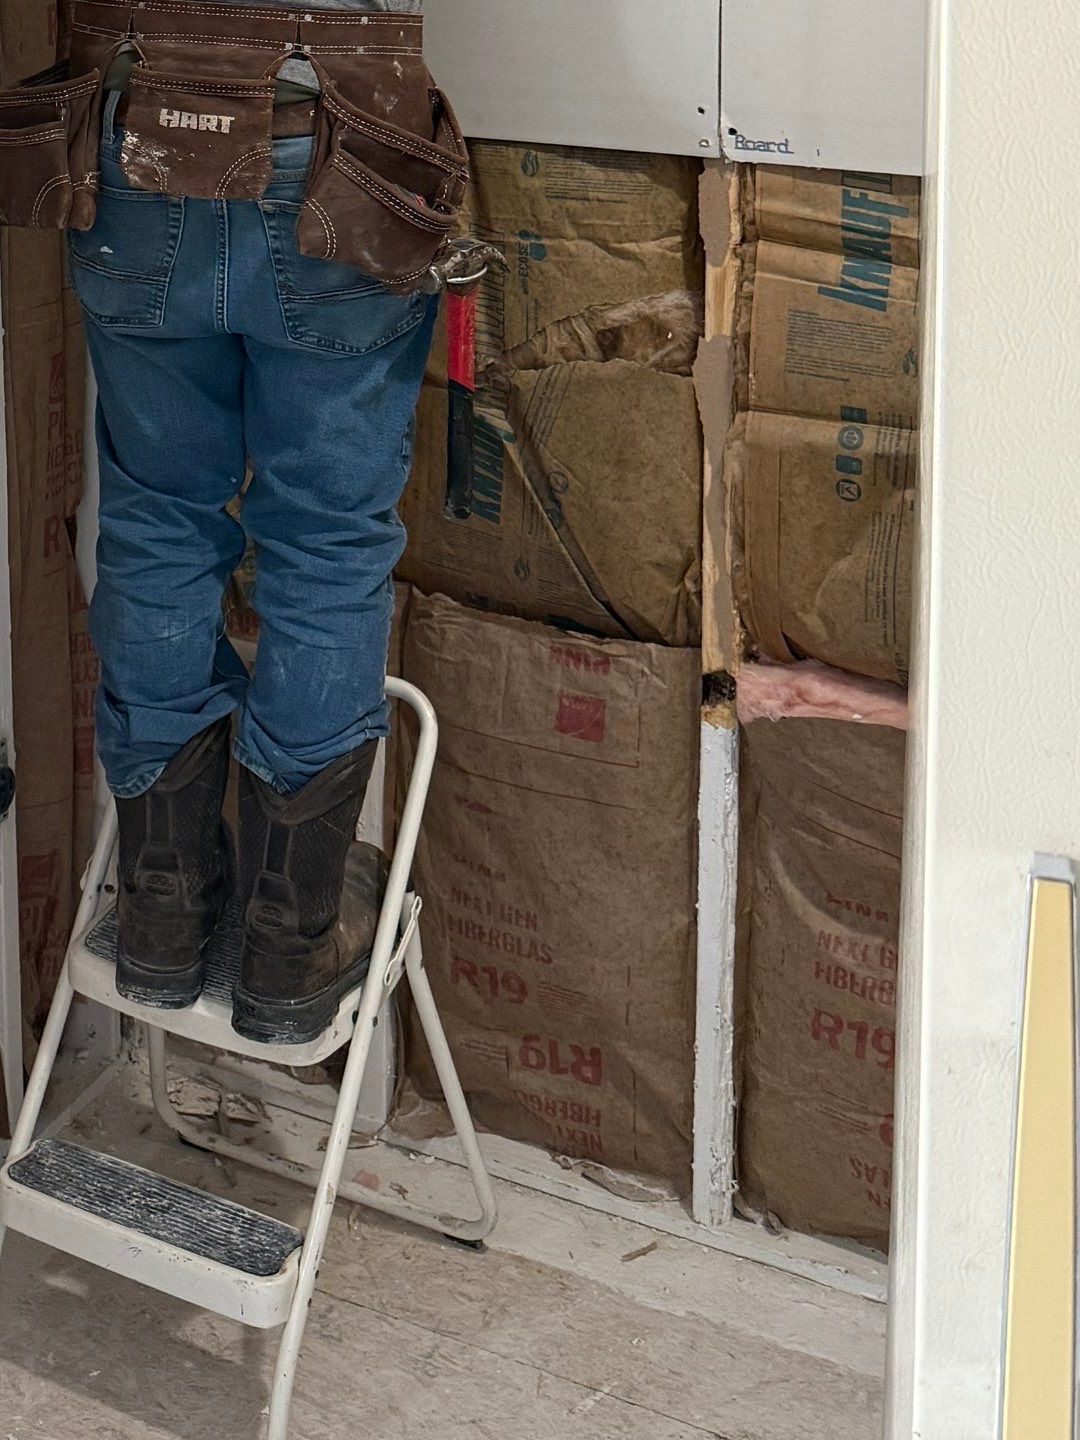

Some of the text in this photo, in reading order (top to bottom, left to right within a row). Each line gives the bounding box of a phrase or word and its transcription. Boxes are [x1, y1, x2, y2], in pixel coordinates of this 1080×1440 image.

[158, 108, 235, 133] HART
[735, 134, 795, 154] Board
[817, 189, 909, 312] KNAUF
[450, 955, 528, 1006] R19
[814, 961, 895, 1006] FIBERG
[518, 1034, 602, 1087] R19
[810, 1007, 895, 1070] R19
